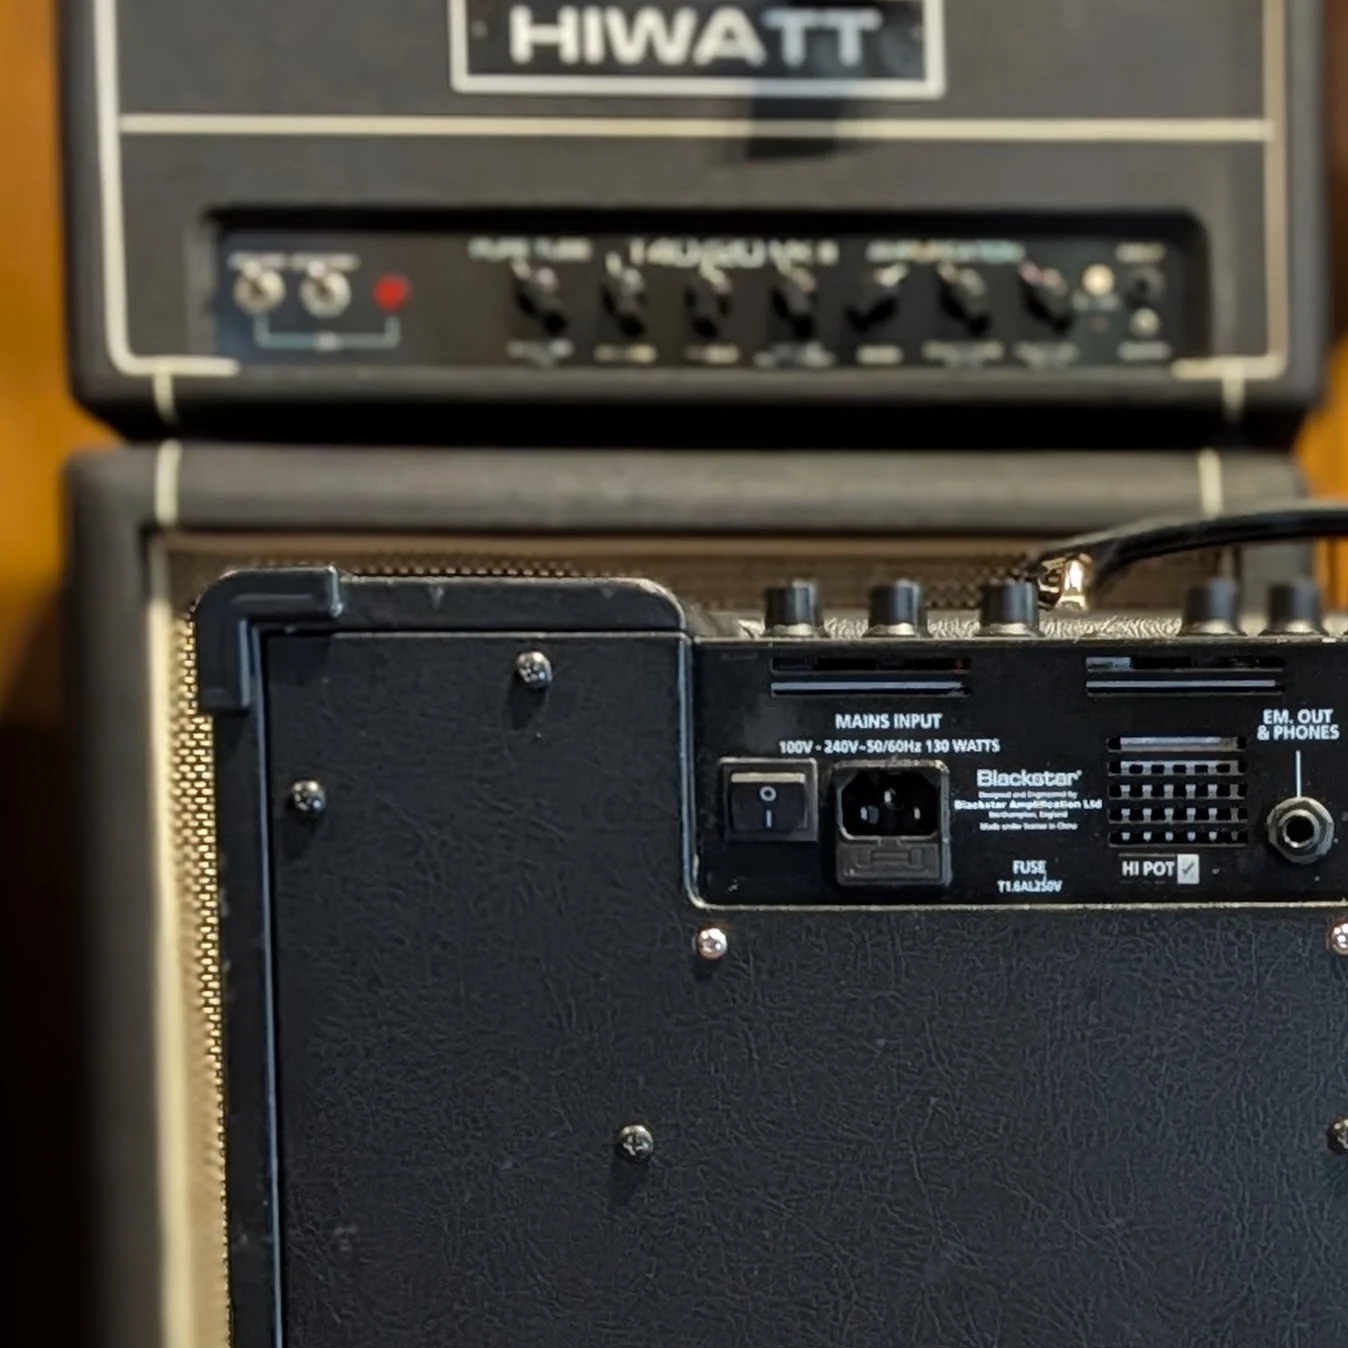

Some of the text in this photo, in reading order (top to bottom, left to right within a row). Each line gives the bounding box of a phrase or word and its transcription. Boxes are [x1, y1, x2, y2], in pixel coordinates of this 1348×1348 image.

[509, 4, 882, 67] HIWATT
[835, 713, 943, 729] MAINS INPUT
[1263, 709, 1334, 724] EM. OUT
[1273, 724, 1340, 740] PHONES
[779, 740, 814, 754] 100V
[925, 740, 949, 753] 130
[952, 738, 1000, 752] WATTS
[954, 800, 1007, 810] Blackstar
[1012, 860, 1047, 875] FUSE
[1122, 861, 1175, 876] HI POT
